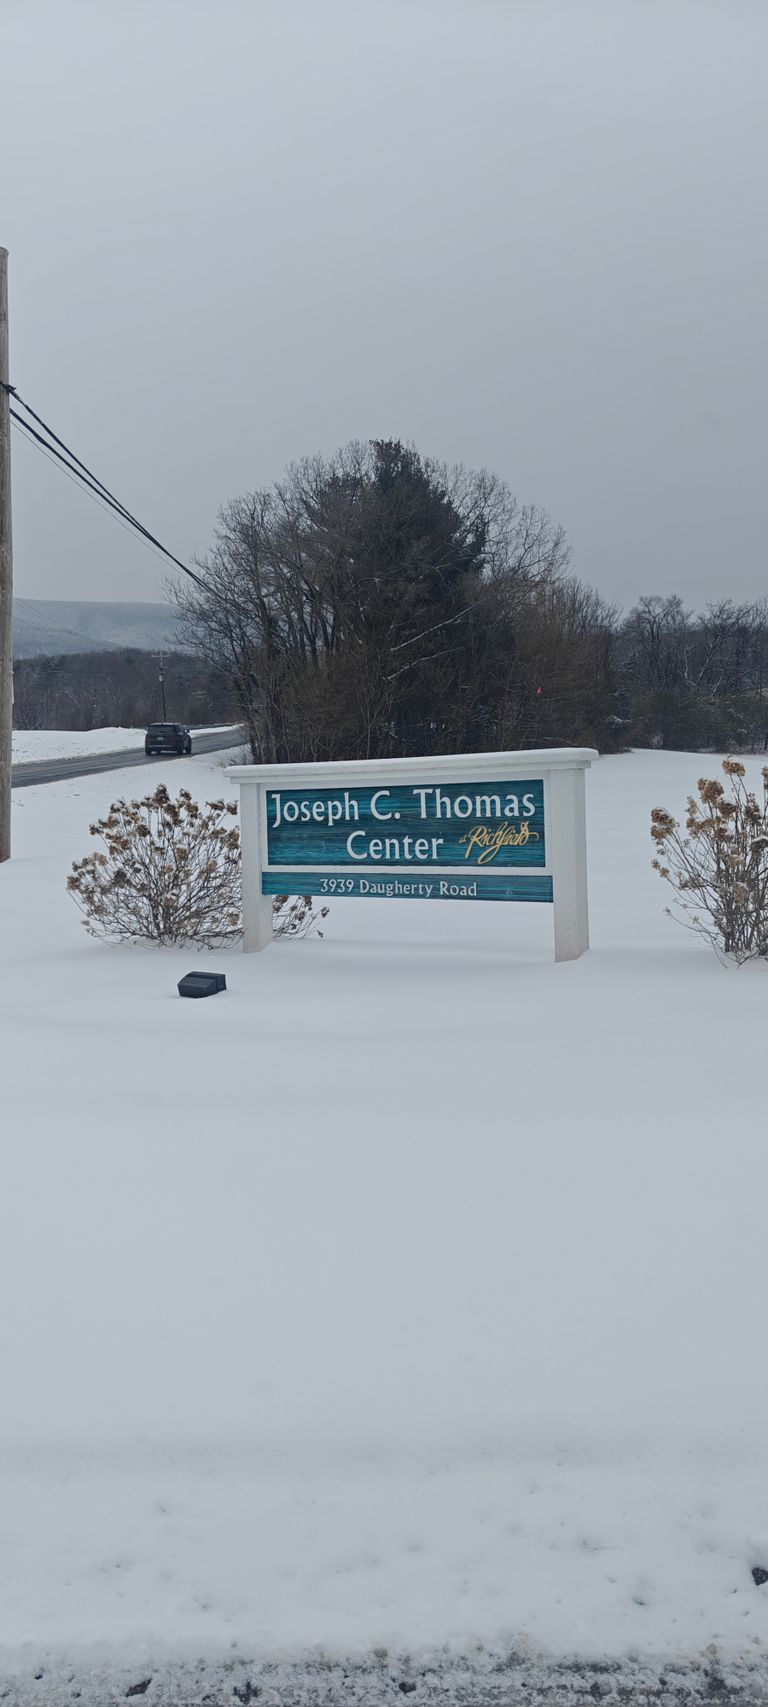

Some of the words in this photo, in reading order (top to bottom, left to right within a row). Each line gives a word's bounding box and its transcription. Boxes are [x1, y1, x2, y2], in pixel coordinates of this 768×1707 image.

[271, 792, 359, 828] Joseph
[370, 790, 401, 820] C.
[412, 788, 536, 819] Thomas
[346, 831, 443, 860] Center
[464, 821, 539, 865] Richfield
[320, 878, 354, 894] 3939
[359, 880, 433, 898] Daugherty
[440, 881, 477, 897] Road
